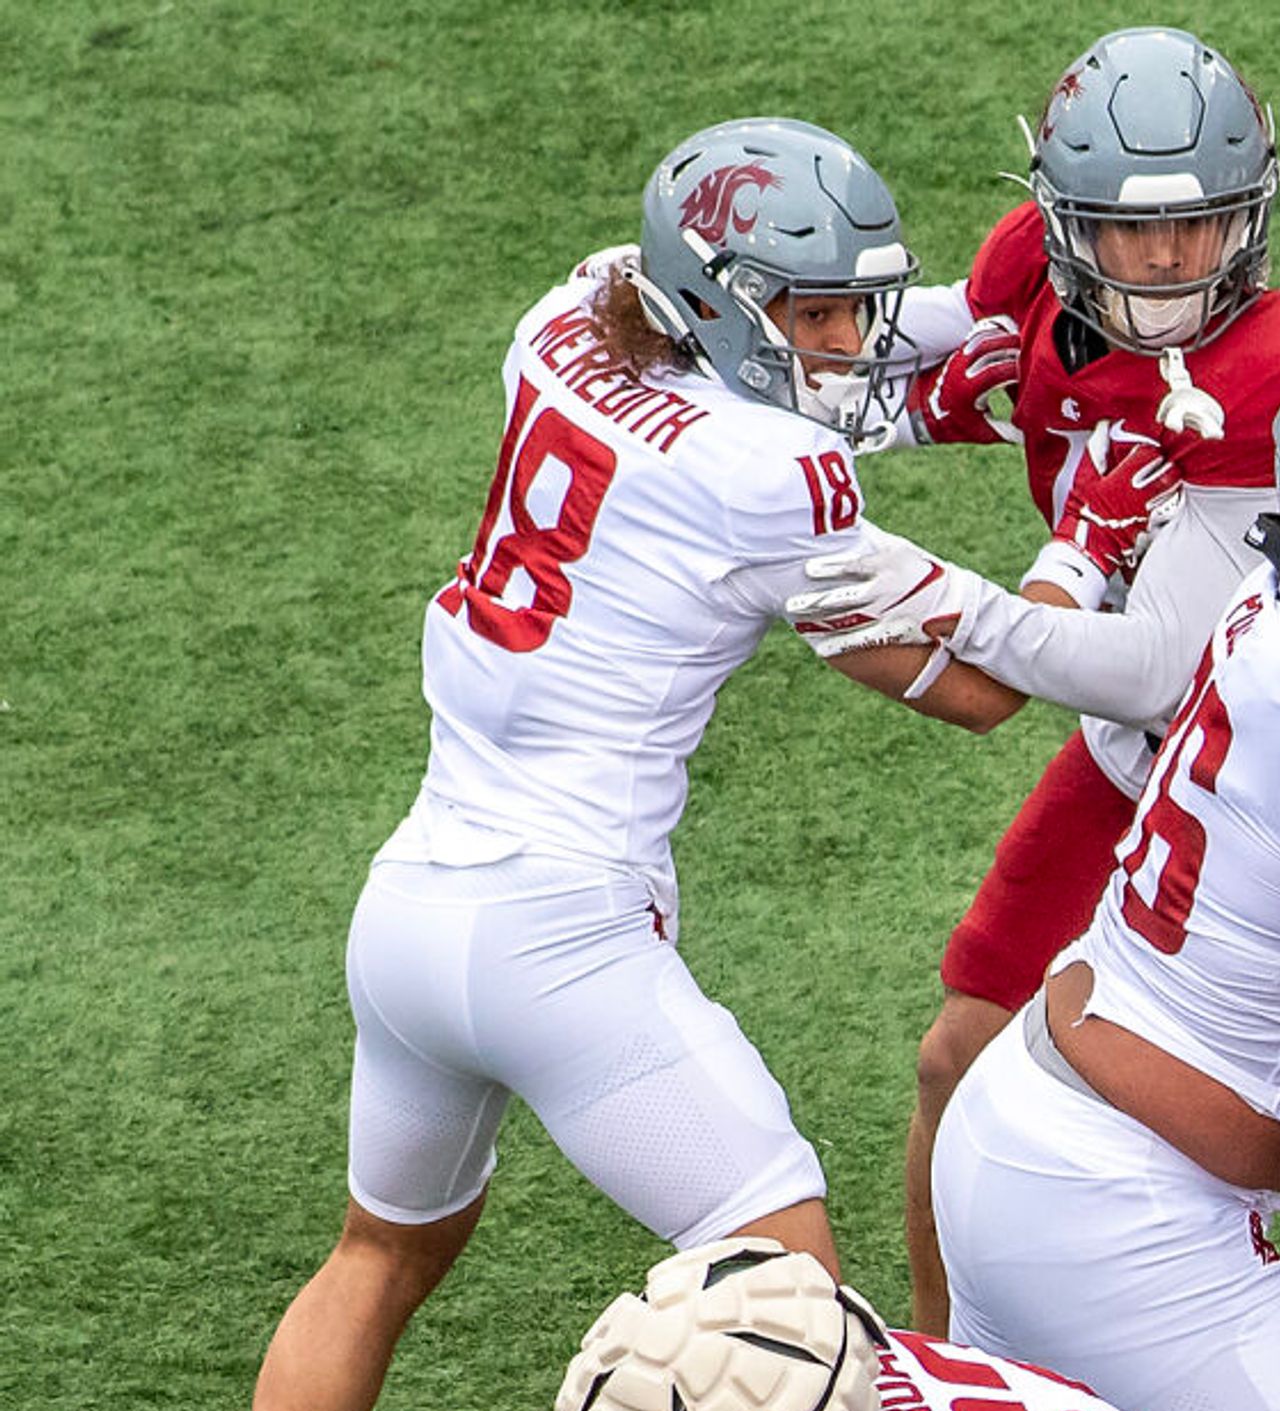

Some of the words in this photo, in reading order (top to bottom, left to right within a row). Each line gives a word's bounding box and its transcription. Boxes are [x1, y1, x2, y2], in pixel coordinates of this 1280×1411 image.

[528, 305, 711, 454] MEREDITH
[436, 371, 618, 654] 18
[795, 450, 859, 537] 18
